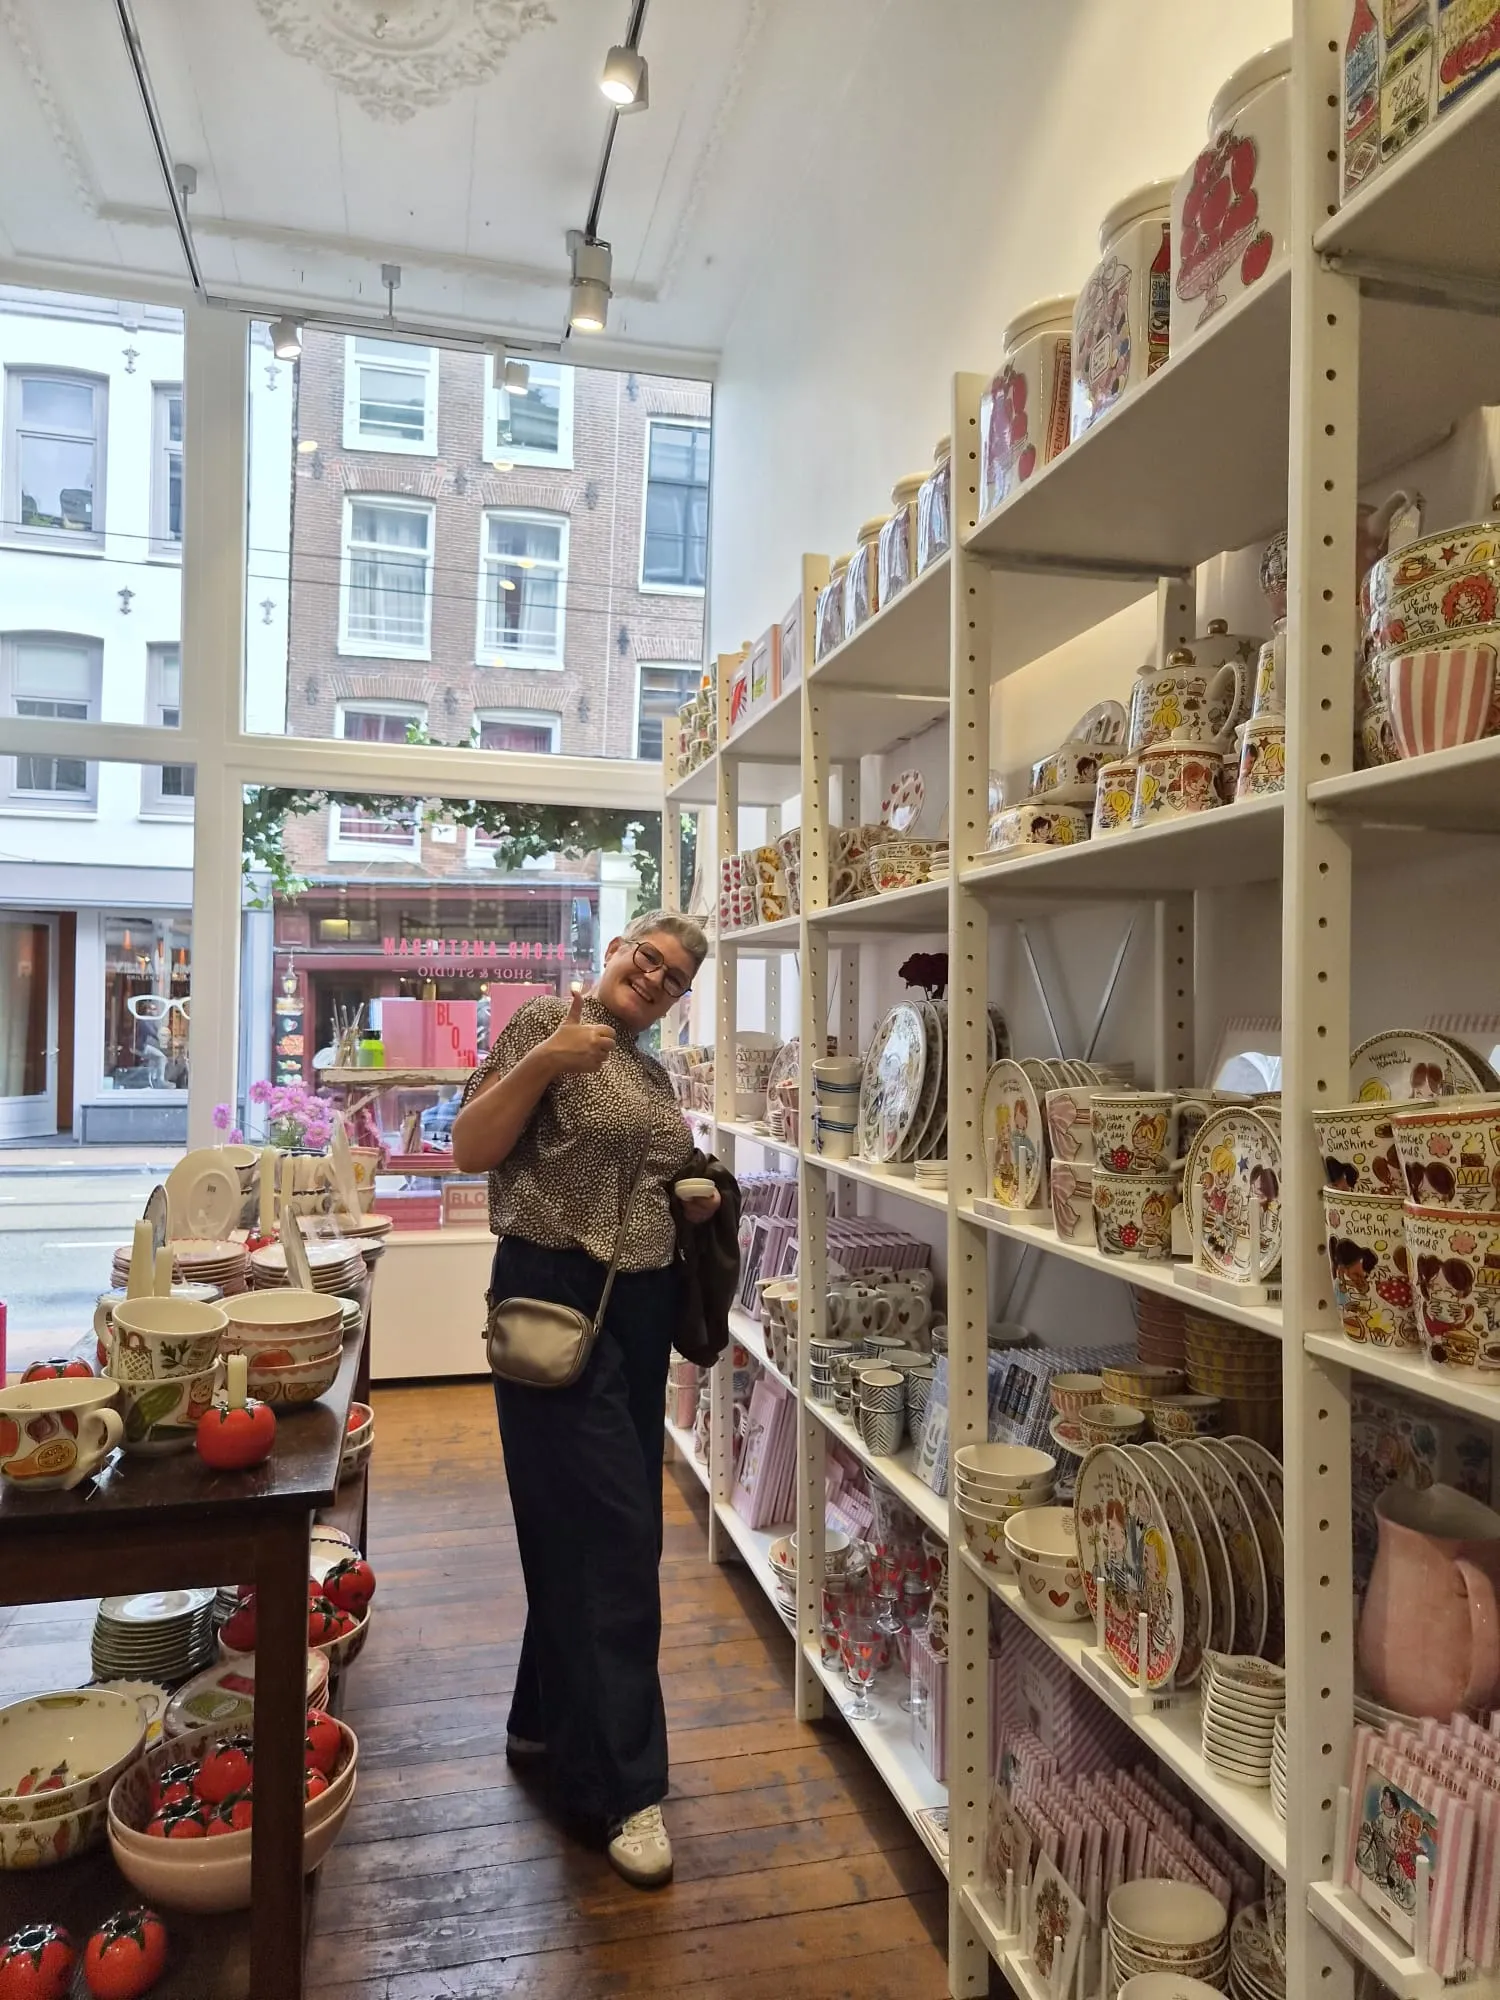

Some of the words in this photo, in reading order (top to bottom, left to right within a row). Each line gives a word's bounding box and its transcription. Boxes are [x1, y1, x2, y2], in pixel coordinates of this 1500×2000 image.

[1329, 1126, 1347, 1141] Cup
[1351, 1125, 1363, 1138] of
[1326, 1138, 1378, 1152] Sunshine
[1351, 1209, 1372, 1224] Cup
[1377, 1211, 1390, 1223] of
[1345, 1221, 1402, 1238] Sunshine
